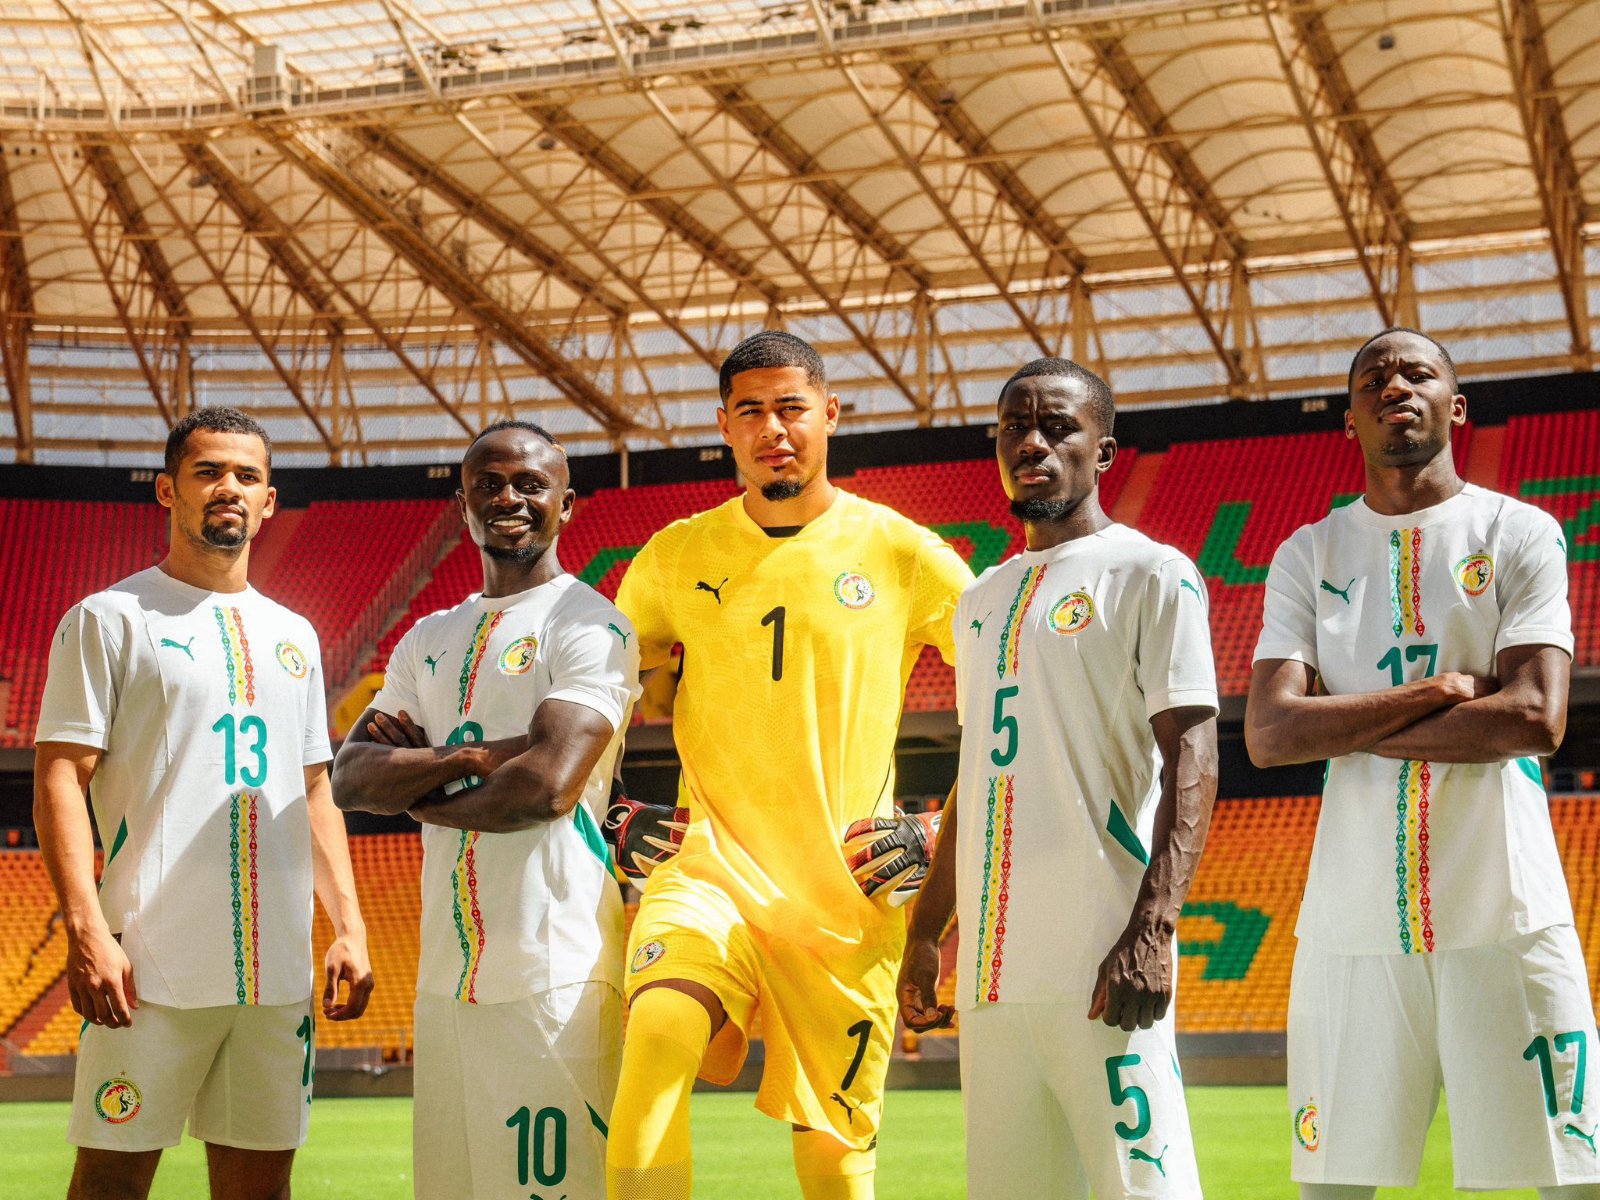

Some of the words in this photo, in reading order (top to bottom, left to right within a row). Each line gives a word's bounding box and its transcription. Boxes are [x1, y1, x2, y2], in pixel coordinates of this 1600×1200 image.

[760, 606, 785, 681] 1
[1377, 643, 1439, 687] 17
[211, 713, 269, 789] 13
[991, 686, 1020, 768] 5
[841, 1019, 873, 1091] 1
[1522, 1030, 1589, 1119] 17
[1105, 1053, 1152, 1142] 5
[506, 1106, 568, 1187] 10
